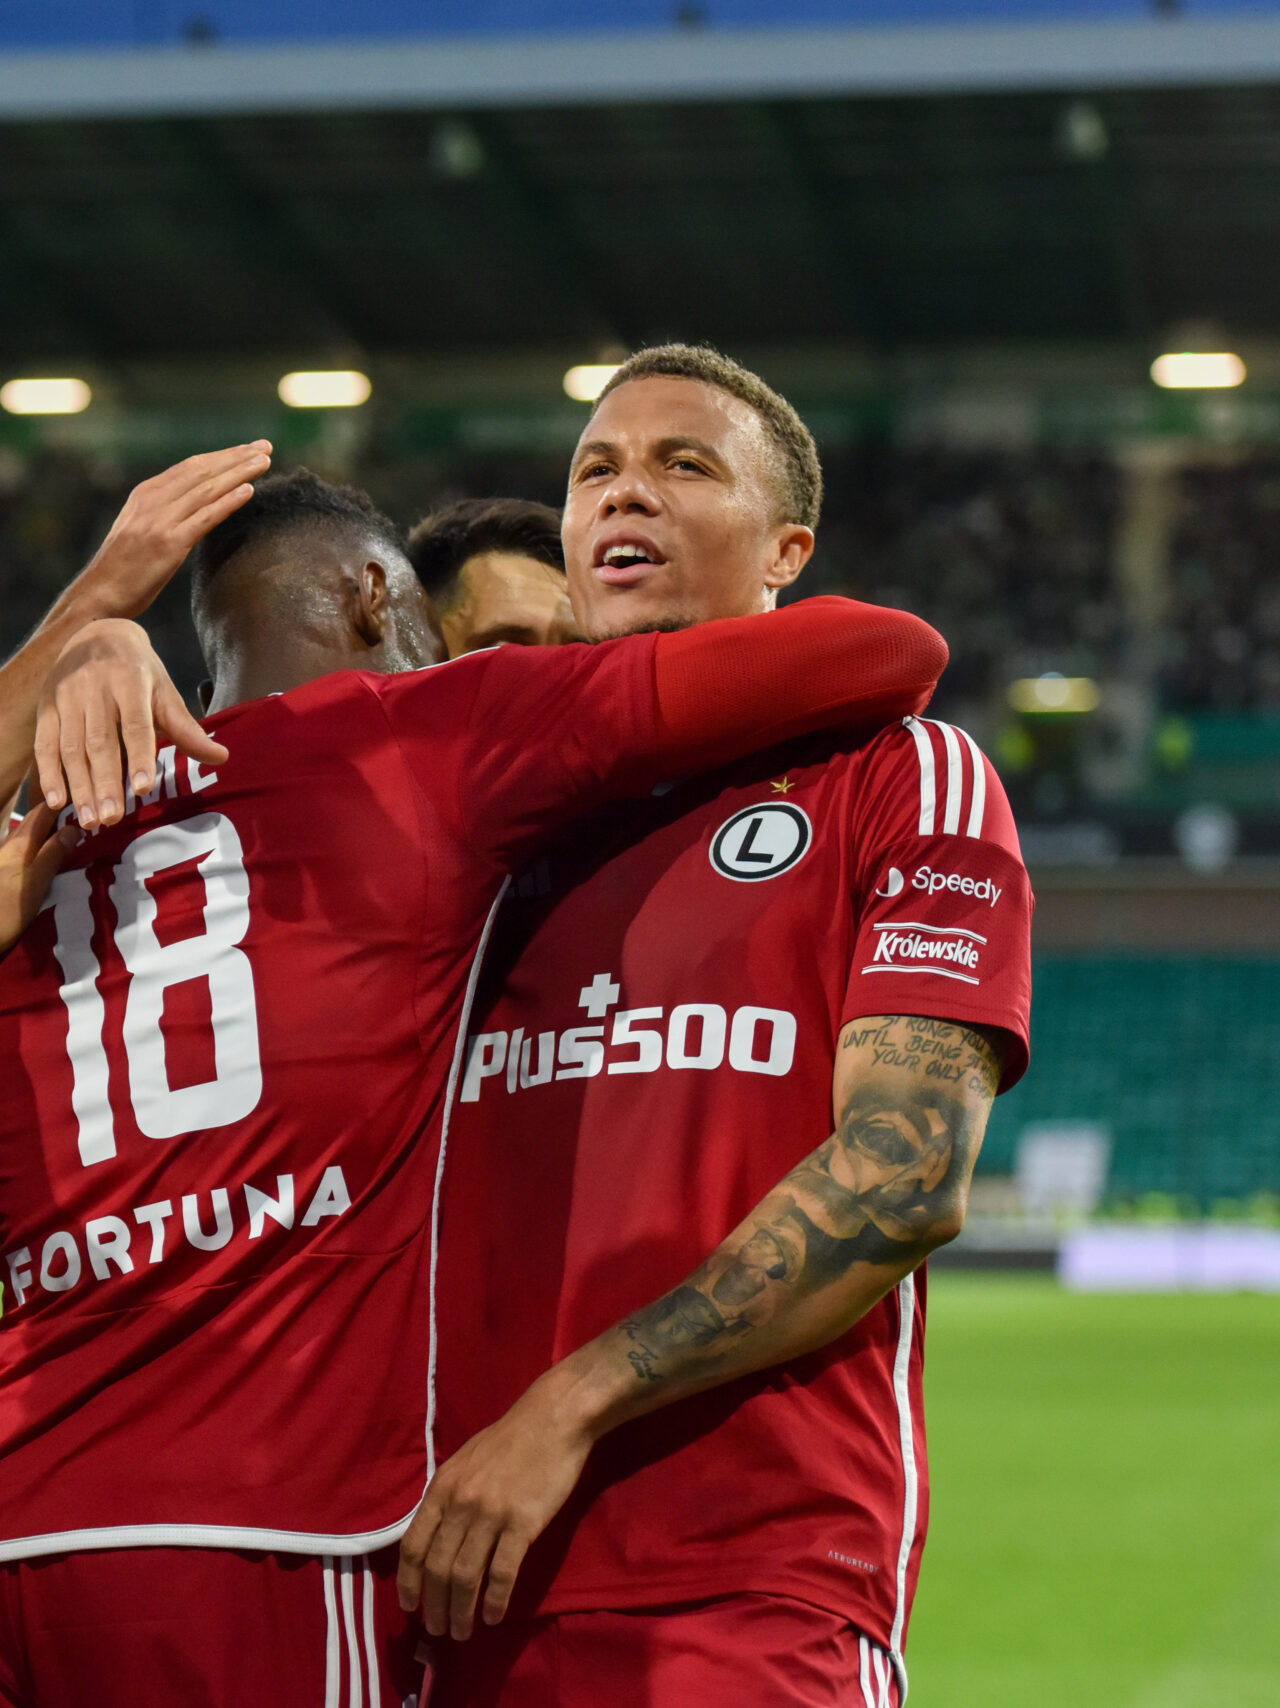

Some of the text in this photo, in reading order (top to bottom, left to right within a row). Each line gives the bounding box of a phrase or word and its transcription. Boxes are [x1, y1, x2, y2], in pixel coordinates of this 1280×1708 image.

[912, 866, 1002, 908] Speedy
[873, 931, 979, 968] Królewskie
[37, 811, 263, 1167] 18
[460, 1003, 797, 1102] Plus500
[843, 1029, 896, 1048] UNTIL
[904, 1035, 962, 1060] BEING
[871, 1048, 967, 1084] YOUR ONLY
[5, 1165, 352, 1306] FORTUNA
[828, 1550, 879, 1574] AEROREADY
